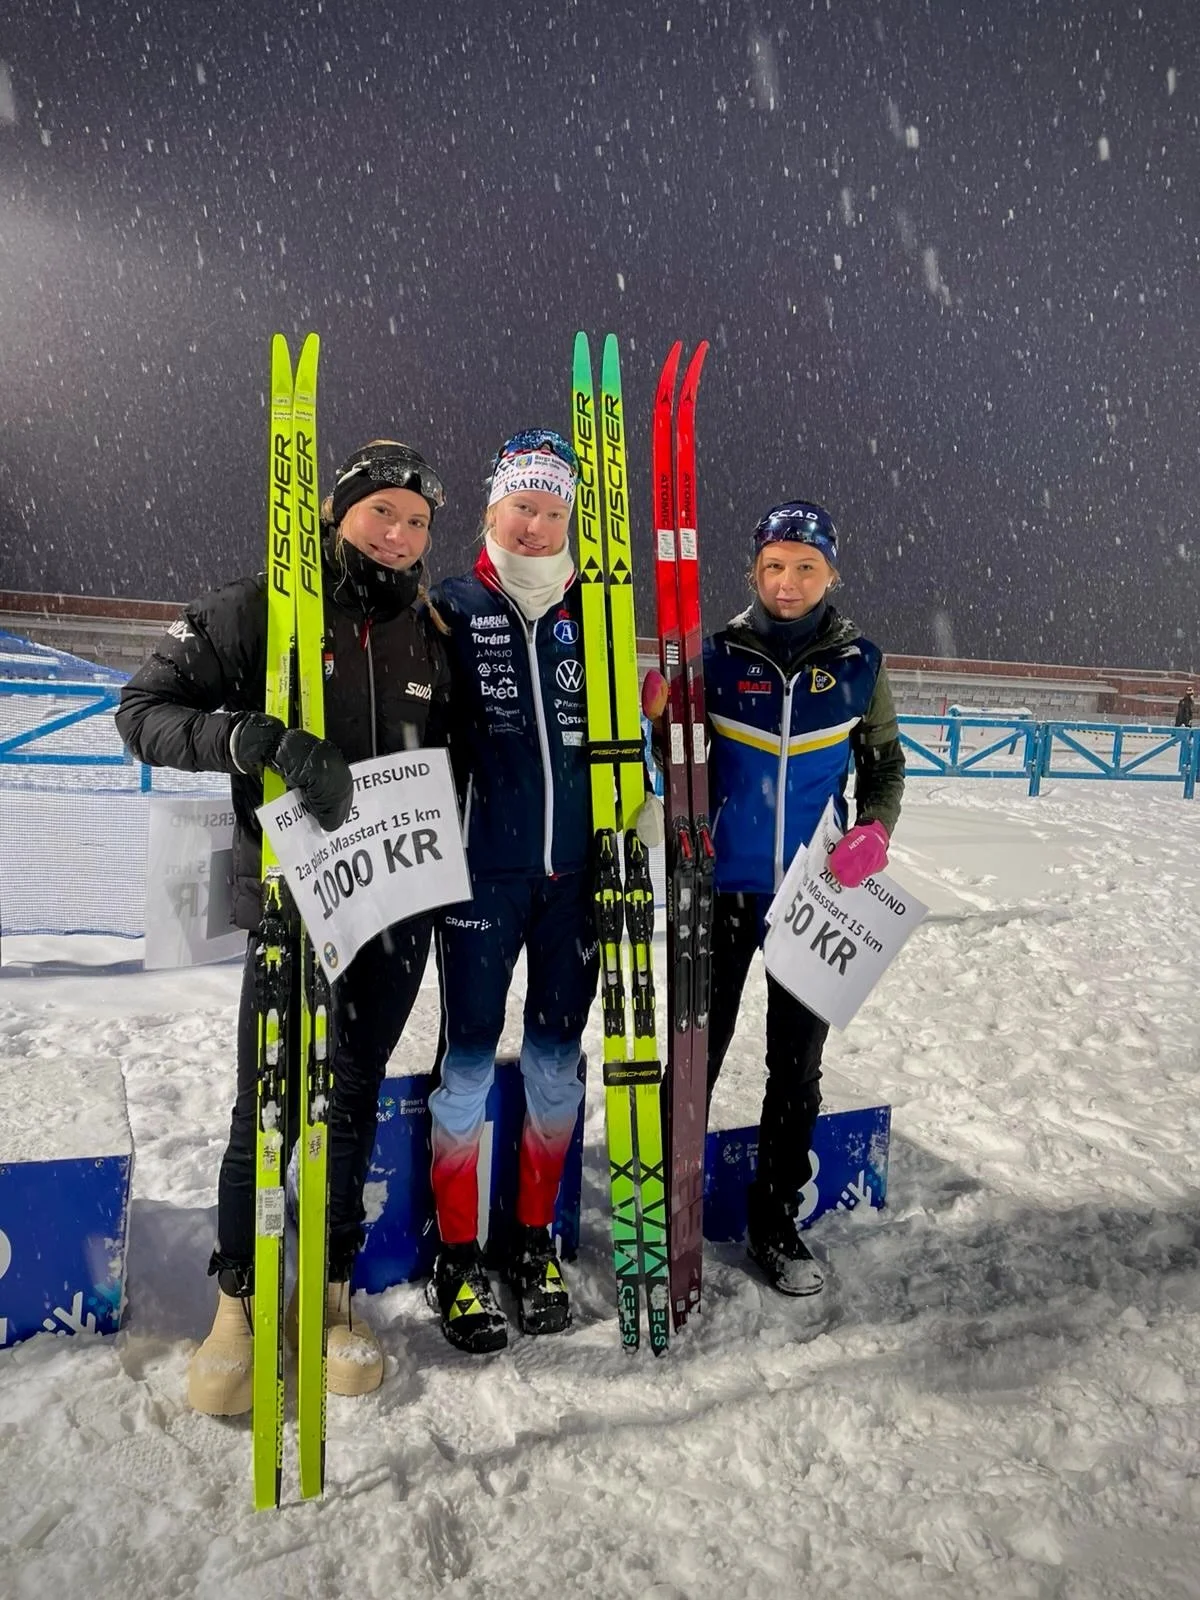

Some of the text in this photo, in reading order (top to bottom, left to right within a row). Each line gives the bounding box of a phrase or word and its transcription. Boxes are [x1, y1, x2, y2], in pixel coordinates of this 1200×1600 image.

[576, 391, 598, 544] FISCHER
[605, 393, 627, 546] FISCHER
[273, 433, 292, 597] FISCHER
[296, 430, 318, 598] FISCHER
[471, 633, 511, 646] Toréns
[492, 664, 515, 674] SCA
[590, 747, 641, 757] FISCHER
[353, 762, 430, 792] TERSUND
[275, 800, 310, 831] FIS JUN
[295, 862, 312, 881] 2:a
[330, 819, 388, 856] Masstart
[392, 811, 411, 828] 15
[415, 807, 441, 823] km
[313, 828, 443, 920] 1000 KR
[445, 916, 481, 930] CRAFT
[808, 878, 883, 953] Masstart 15 km
[784, 890, 857, 976] 50 KR
[607, 1070, 659, 1079] FISCHER
[400, 1098, 424, 1107] Smart
[400, 1106, 426, 1116] Energy
